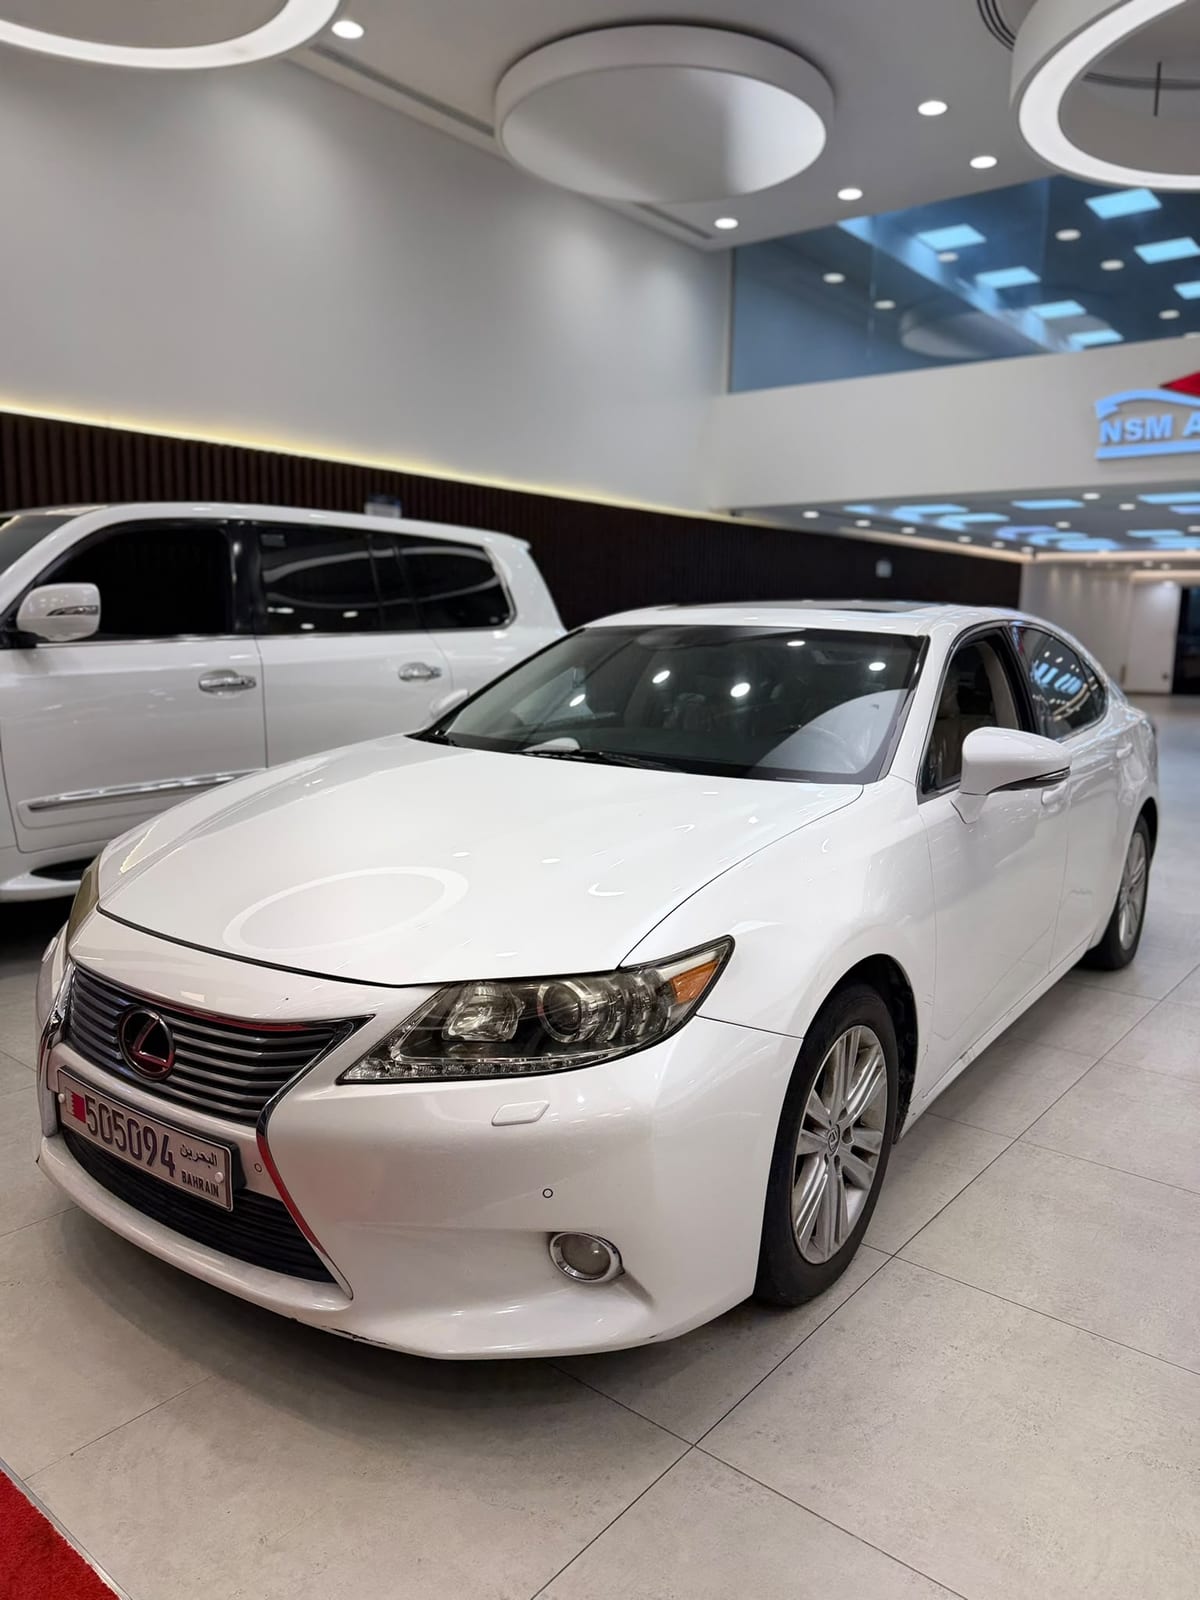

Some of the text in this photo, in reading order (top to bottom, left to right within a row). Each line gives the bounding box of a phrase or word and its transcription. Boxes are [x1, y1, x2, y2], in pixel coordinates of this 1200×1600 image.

[1100, 414, 1173, 444] NSM
[84, 1095, 176, 1178] 505094
[180, 1144, 218, 1168] البحرين
[181, 1170, 220, 1198] BAHRAIN
